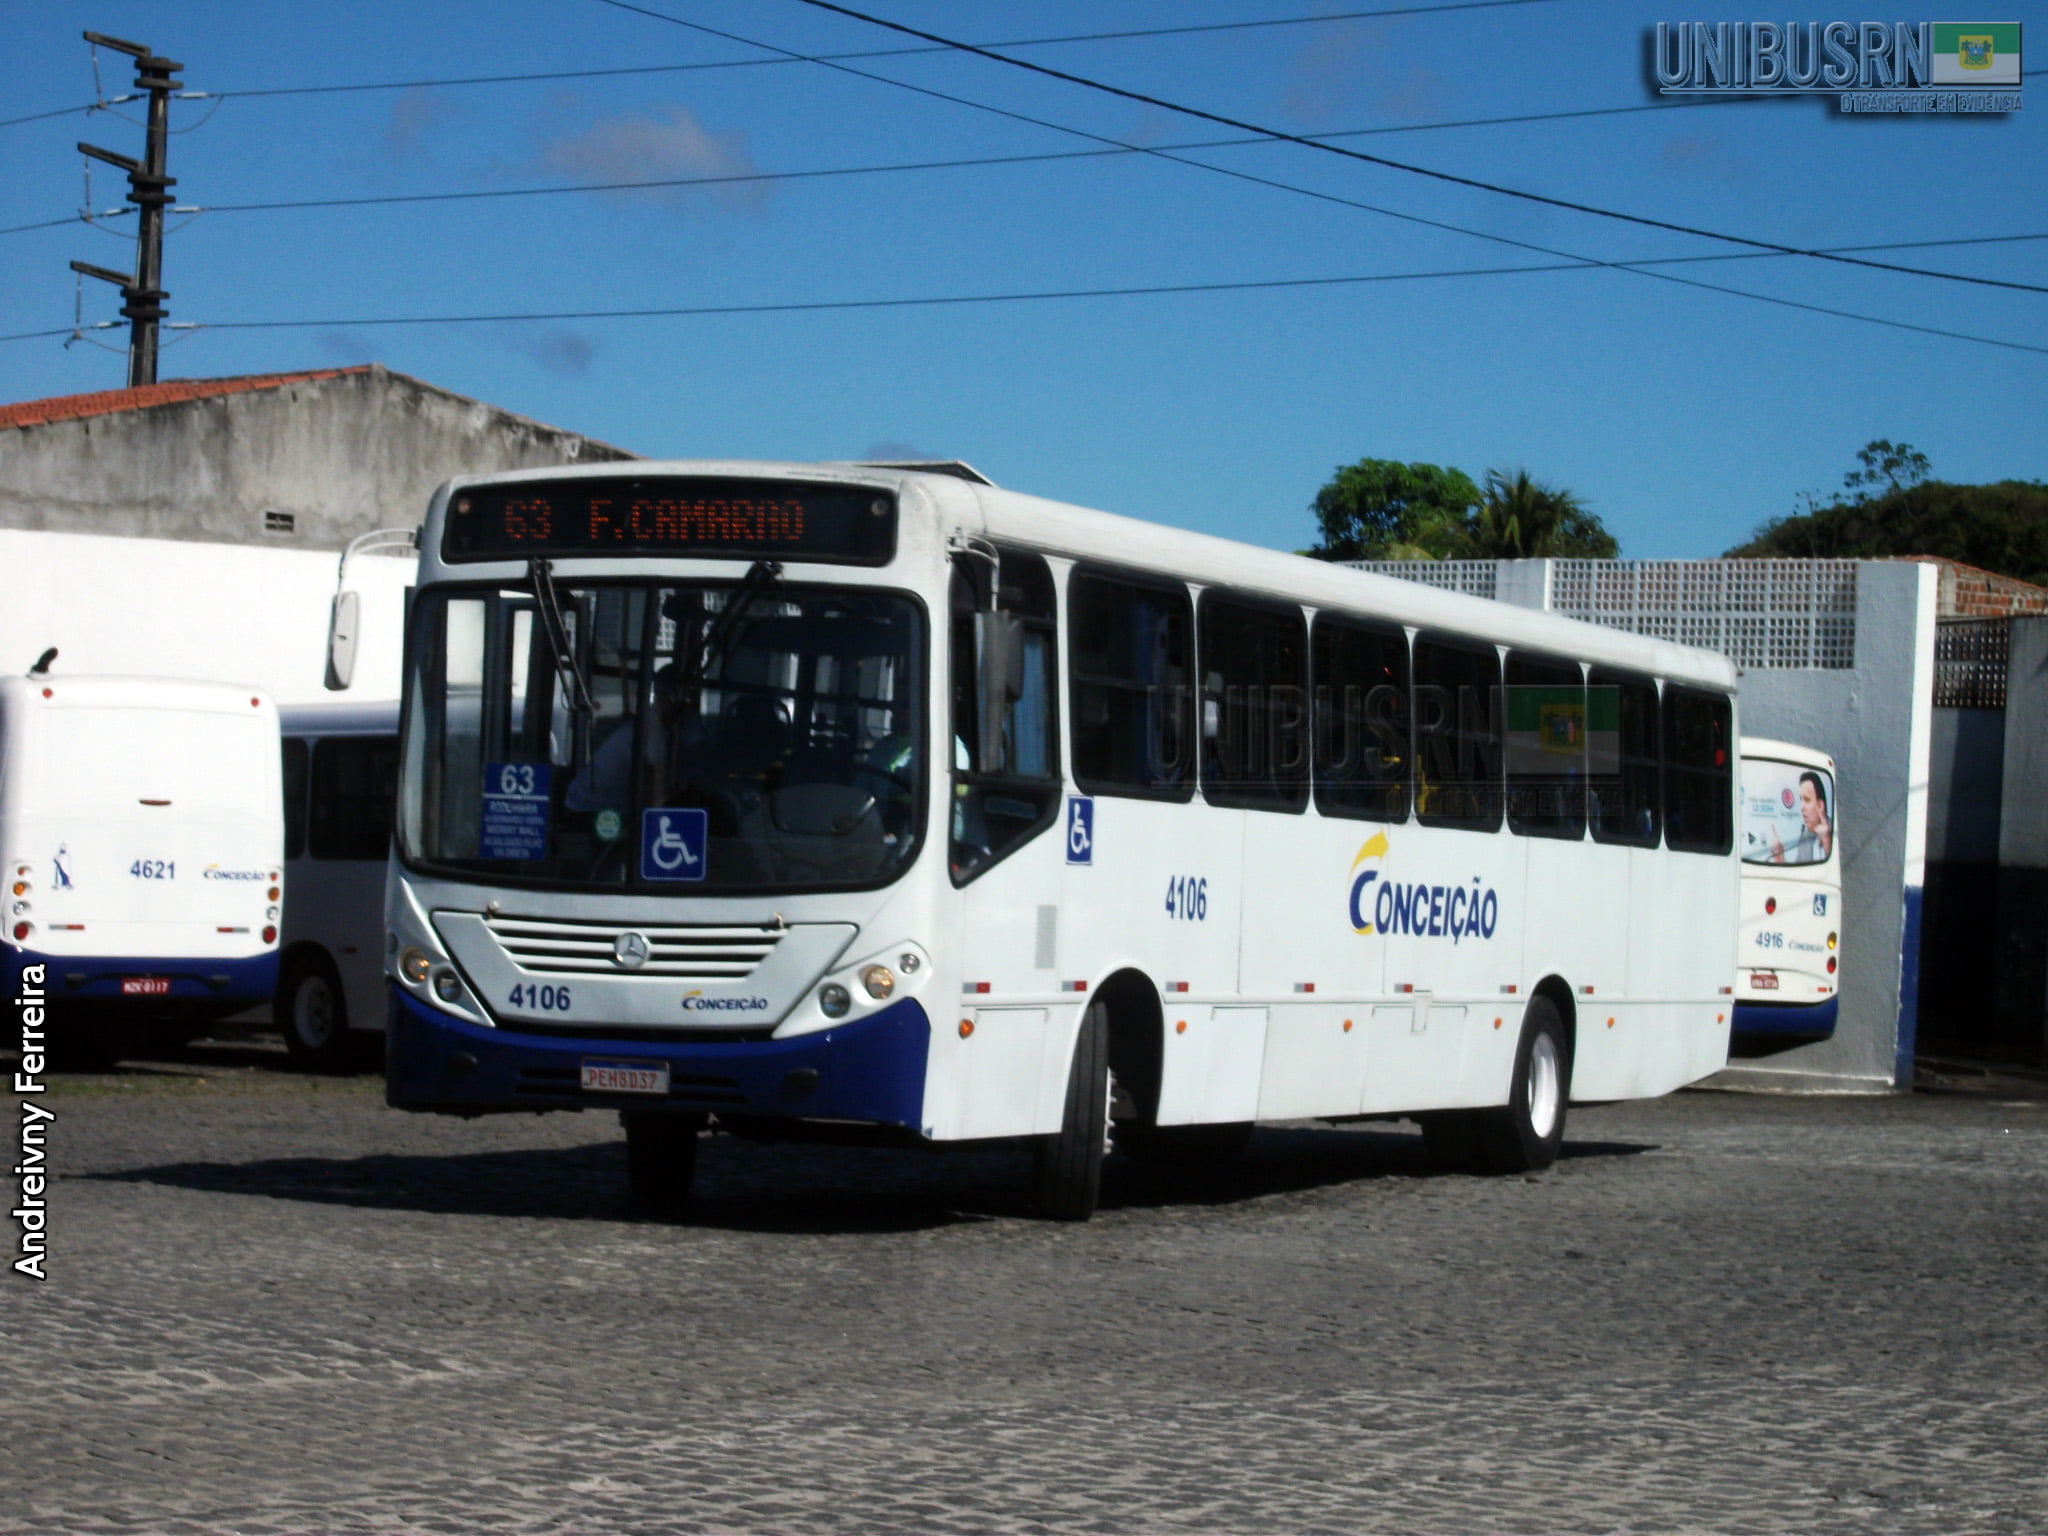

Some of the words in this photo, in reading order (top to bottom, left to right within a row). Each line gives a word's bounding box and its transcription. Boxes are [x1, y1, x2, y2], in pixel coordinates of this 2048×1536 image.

[505, 499, 551, 540] 63
[501, 765, 535, 794] 63
[130, 860, 176, 879] 4621
[1165, 875, 1207, 922] 4106
[1349, 868, 1498, 944] CONCEIÇÃO
[1755, 931, 1783, 949] 4916
[508, 983, 571, 1011] 4106
[682, 992, 768, 1012] CONCEIÇÃO
